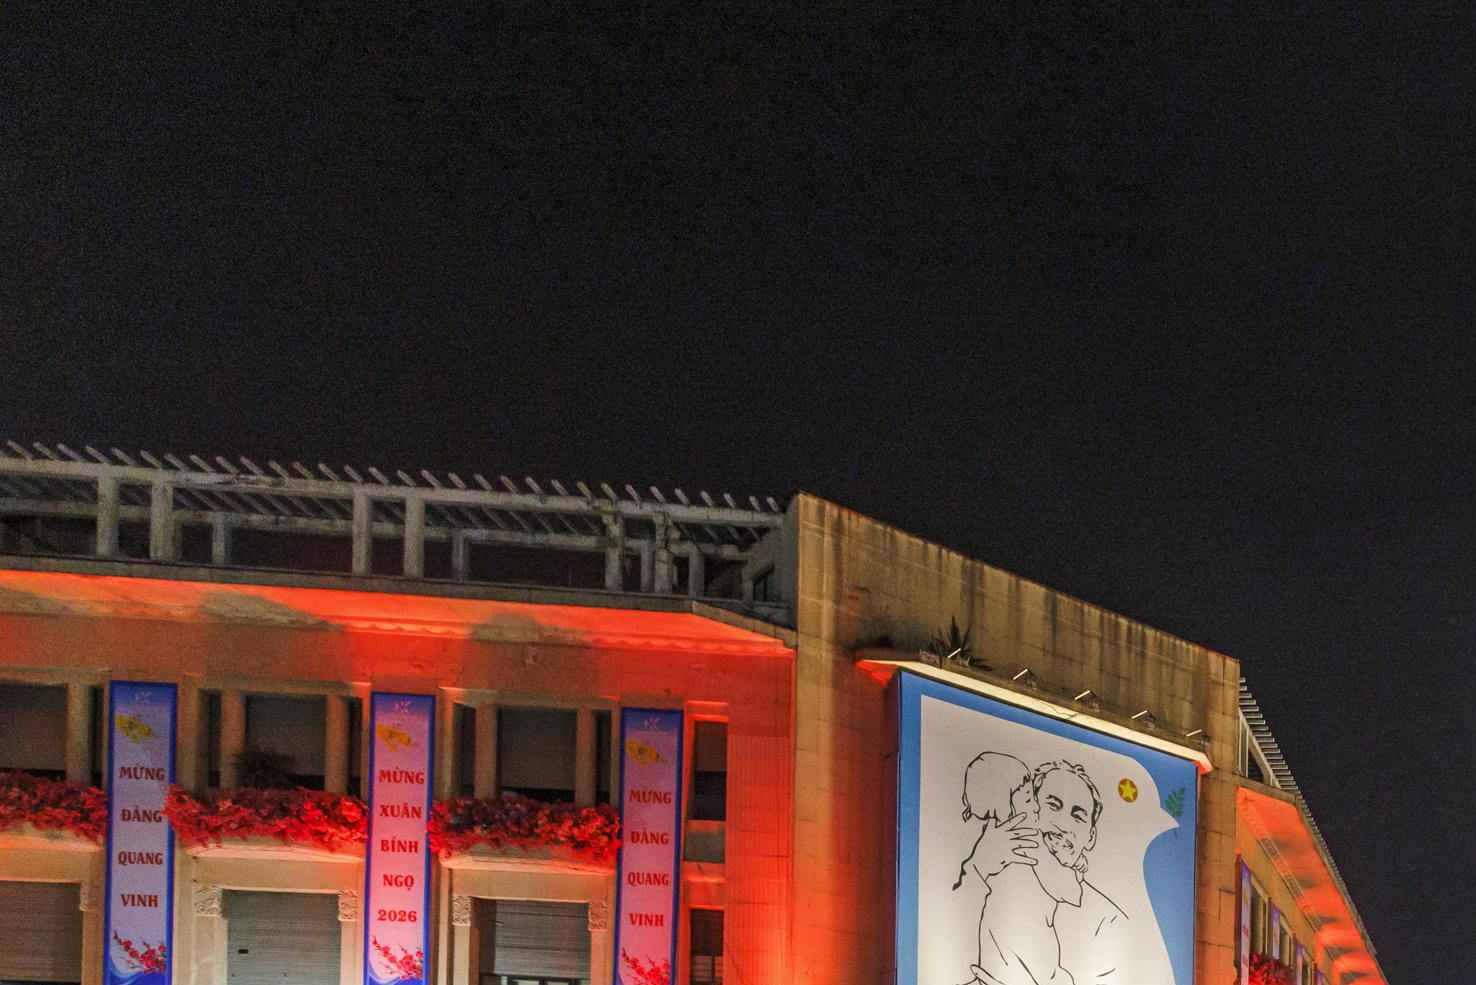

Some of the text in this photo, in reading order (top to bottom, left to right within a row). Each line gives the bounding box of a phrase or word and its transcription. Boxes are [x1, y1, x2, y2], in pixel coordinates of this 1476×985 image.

[119, 763, 165, 781] MỪNG
[379, 767, 425, 785] MỪNG
[629, 788, 672, 804] MỪNG
[379, 802, 422, 819] XUÂN
[380, 836, 419, 853] BÍNH
[118, 851, 164, 866] QUANG
[383, 874, 414, 891] NGỌ
[627, 871, 669, 886] QUANG
[120, 894, 159, 908] VINH
[377, 909, 417, 923] 2026
[629, 913, 664, 927] VINH
